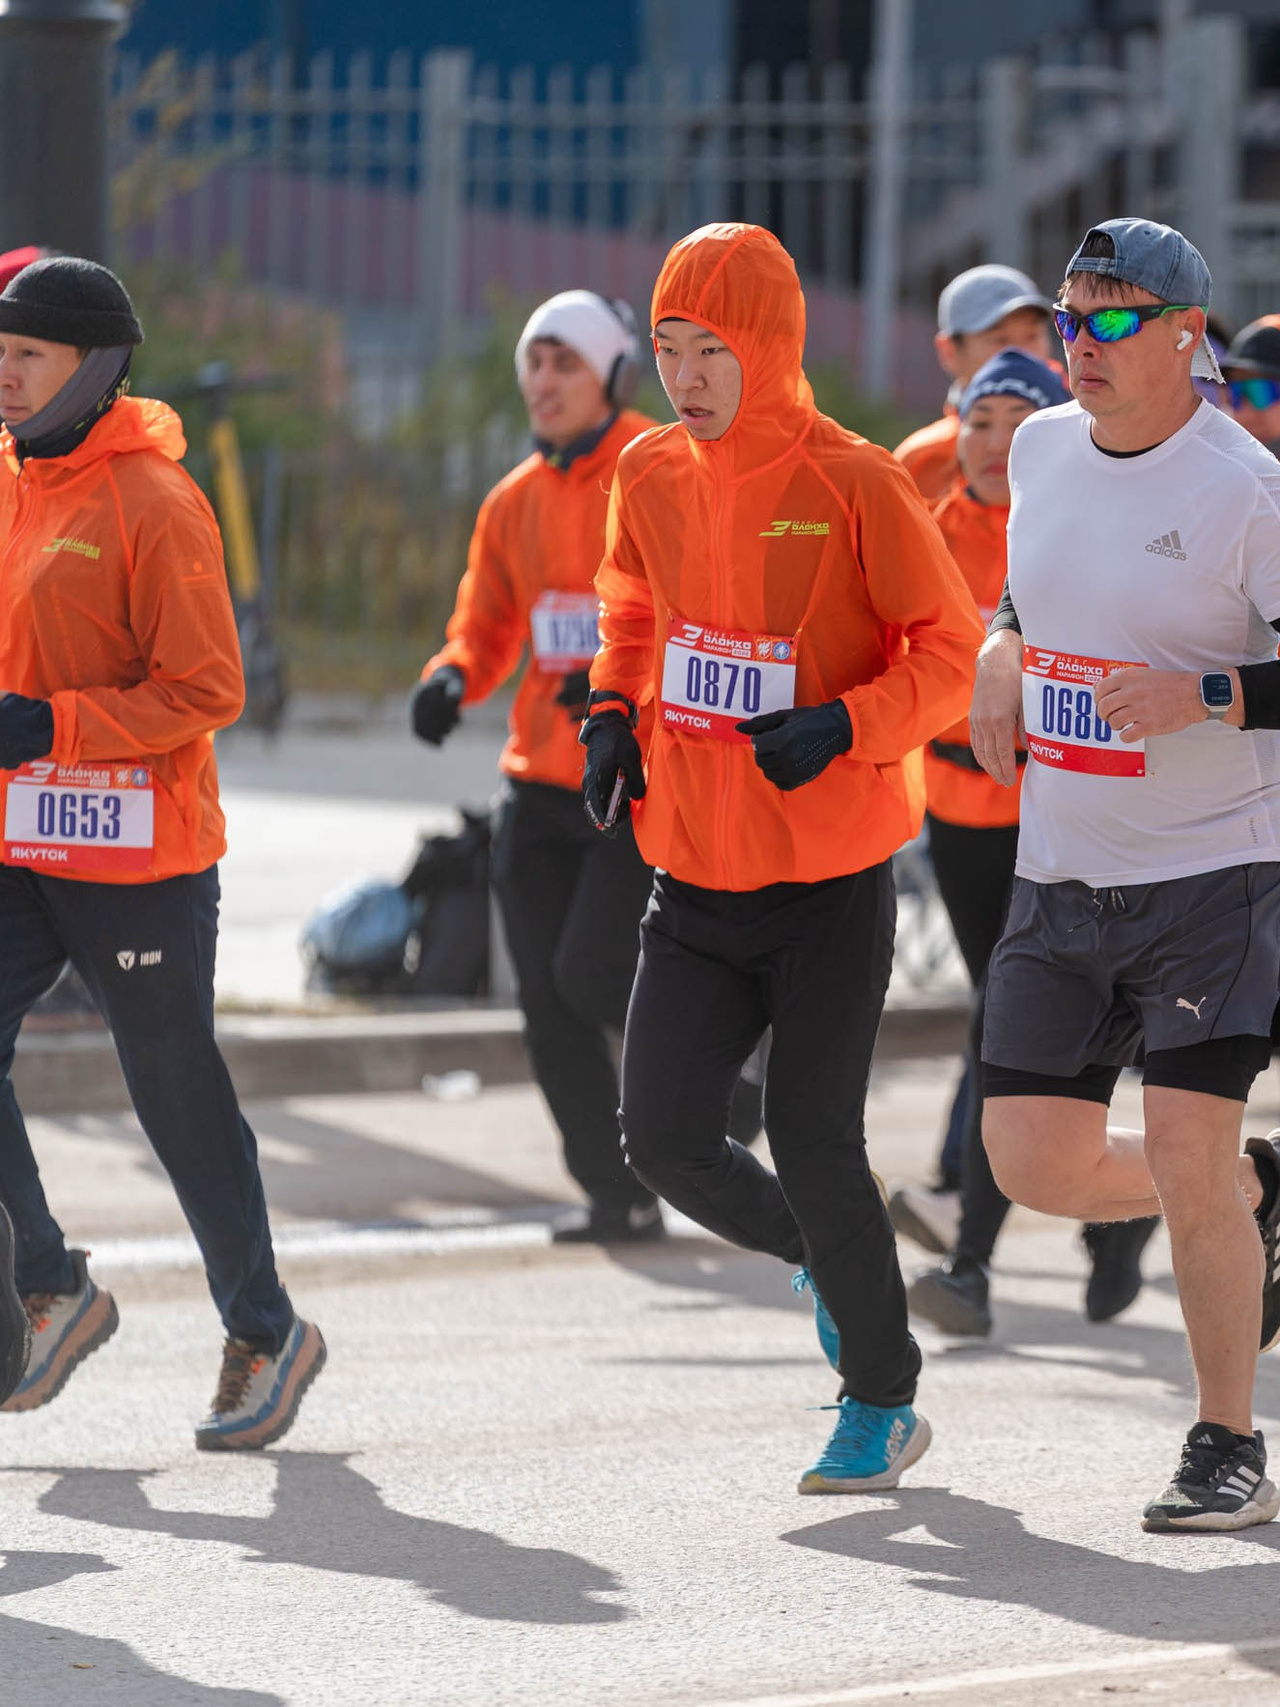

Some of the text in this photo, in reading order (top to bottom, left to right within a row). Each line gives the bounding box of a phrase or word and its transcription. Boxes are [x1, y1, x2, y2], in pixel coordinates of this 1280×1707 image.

[1145, 543, 1187, 561] adidas
[703, 635, 752, 649] ОЛОНХО
[1057, 662, 1103, 675] ОЛОНХО
[686, 656, 762, 713] 0870
[664, 709, 711, 729] ЯКУТСК
[1030, 742, 1064, 761] ЯКУТСК
[38, 792, 121, 840] 0653
[11, 847, 68, 861] ЯКУТСК
